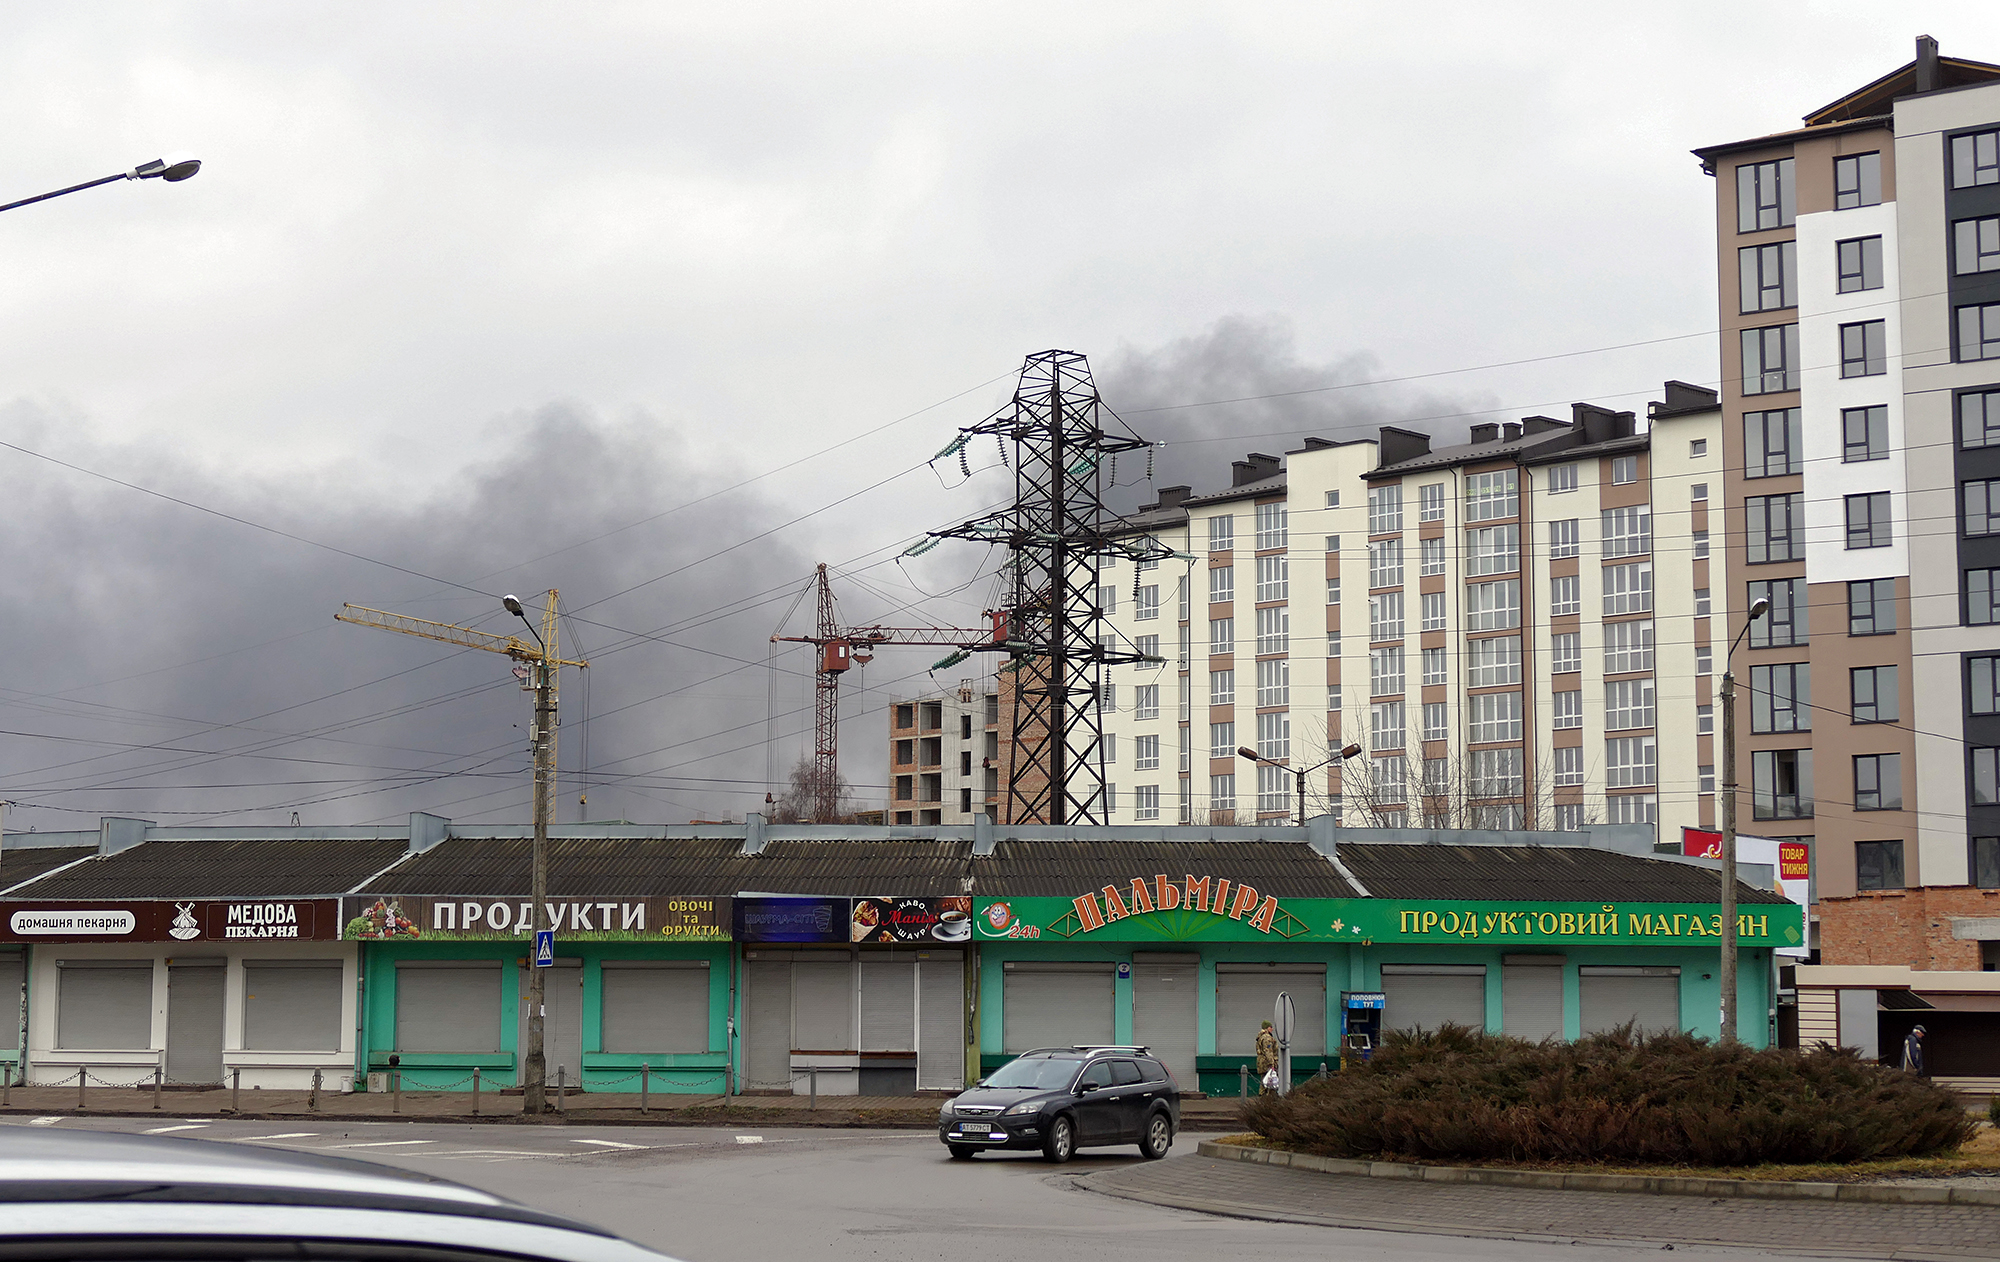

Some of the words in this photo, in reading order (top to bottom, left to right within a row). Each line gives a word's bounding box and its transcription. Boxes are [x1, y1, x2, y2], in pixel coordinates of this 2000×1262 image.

[1781, 848, 1805, 860] ТОВАР
[1782, 863, 1808, 875] ТИЖНЯ
[668, 900, 713, 912] ОВОЧІ
[899, 900, 926, 910] КАВО
[1072, 874, 1278, 934] ПАЛЬМІРА
[227, 903, 297, 926] МЕДОВА
[433, 902, 645, 935] ПРОДУКТИ
[683, 914, 699, 924] та
[881, 910, 938, 926] Манія
[17, 916, 74, 930] домашня
[76, 914, 127, 931] пекарня
[1400, 905, 1619, 938] ПРОДУКТОВИЙ
[225, 926, 299, 939] ПЕКАРНЯ
[662, 924, 720, 937] ФРУКТИ
[897, 928, 926, 940] ШАУР
[1008, 925, 1041, 939] 24h
